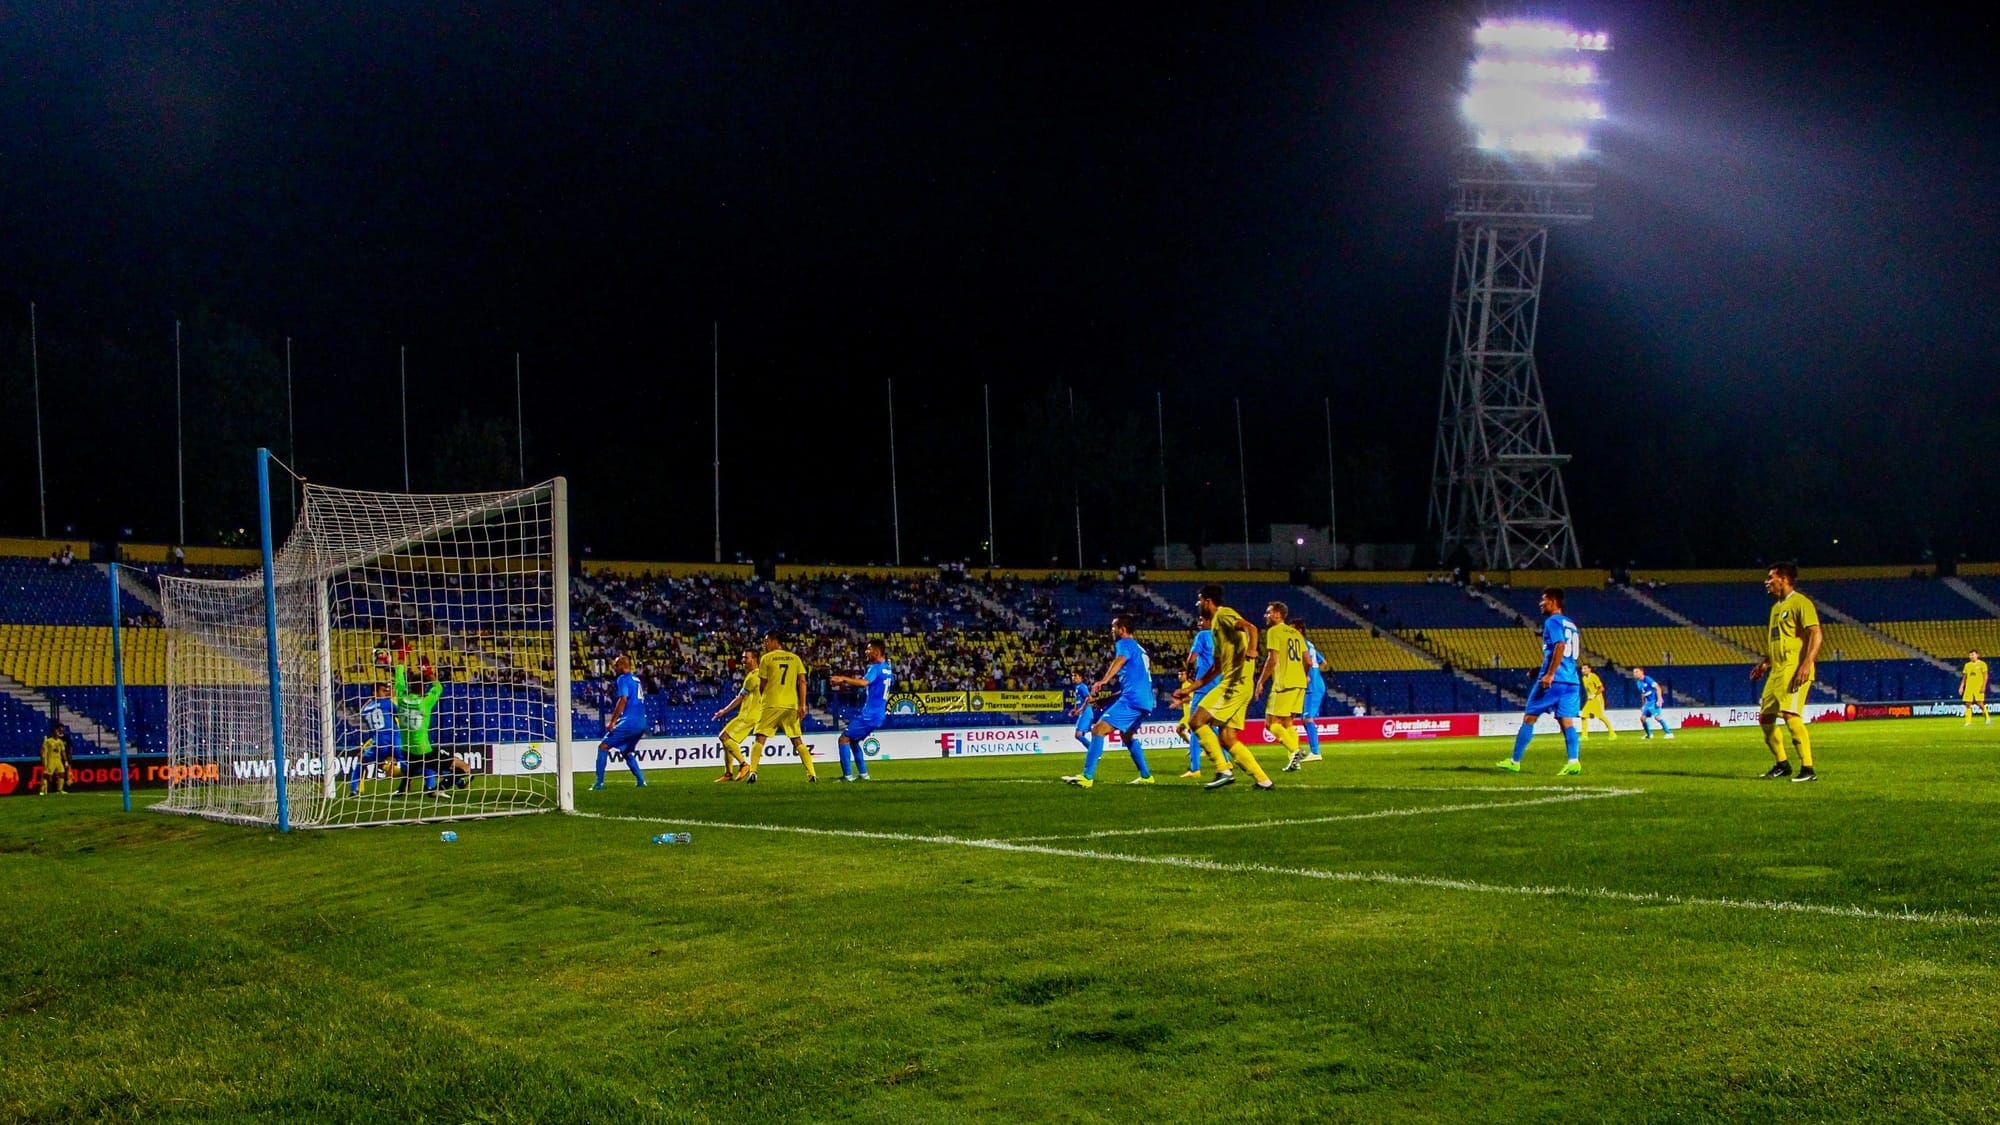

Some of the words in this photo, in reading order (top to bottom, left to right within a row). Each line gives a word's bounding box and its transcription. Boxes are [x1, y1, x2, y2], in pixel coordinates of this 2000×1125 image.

[1288, 638, 1301, 661] 80
[779, 663, 789, 685] 7
[364, 708, 386, 730] 19
[1729, 709, 1760, 722] Делов
[967, 730, 1039, 742] EUROASIA
[967, 742, 1039, 753] INSURANCE
[28, 763, 139, 789] Дловой
[147, 763, 219, 784] город
